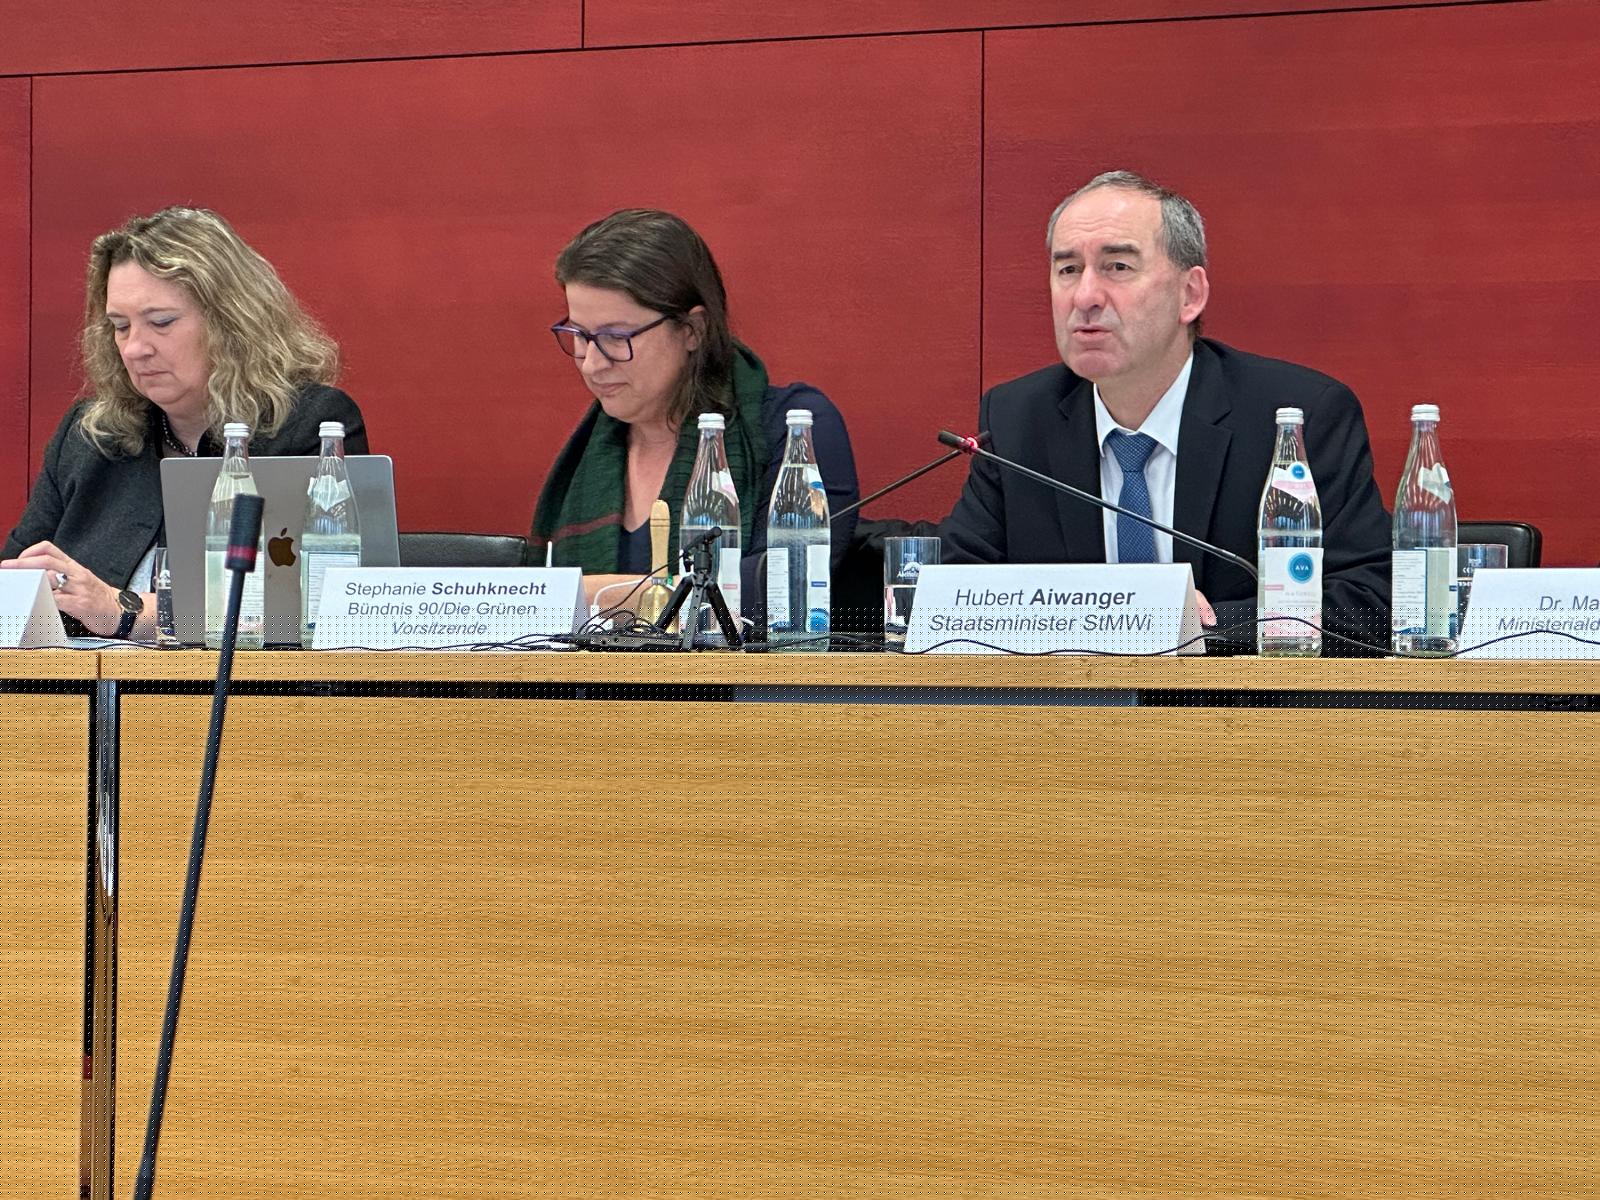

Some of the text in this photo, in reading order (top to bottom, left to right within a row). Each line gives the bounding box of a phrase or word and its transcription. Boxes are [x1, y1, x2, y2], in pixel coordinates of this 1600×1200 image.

[345, 582, 547, 598] Stephanie Schuhknecht
[955, 588, 1136, 609] Hubert Aiwanger
[1539, 596, 1564, 611] Dr.
[348, 602, 537, 615] Bündnis 90/Die Grünen
[392, 621, 488, 635] Vorsitzende
[929, 614, 1152, 631] Staatsminister StMWi
